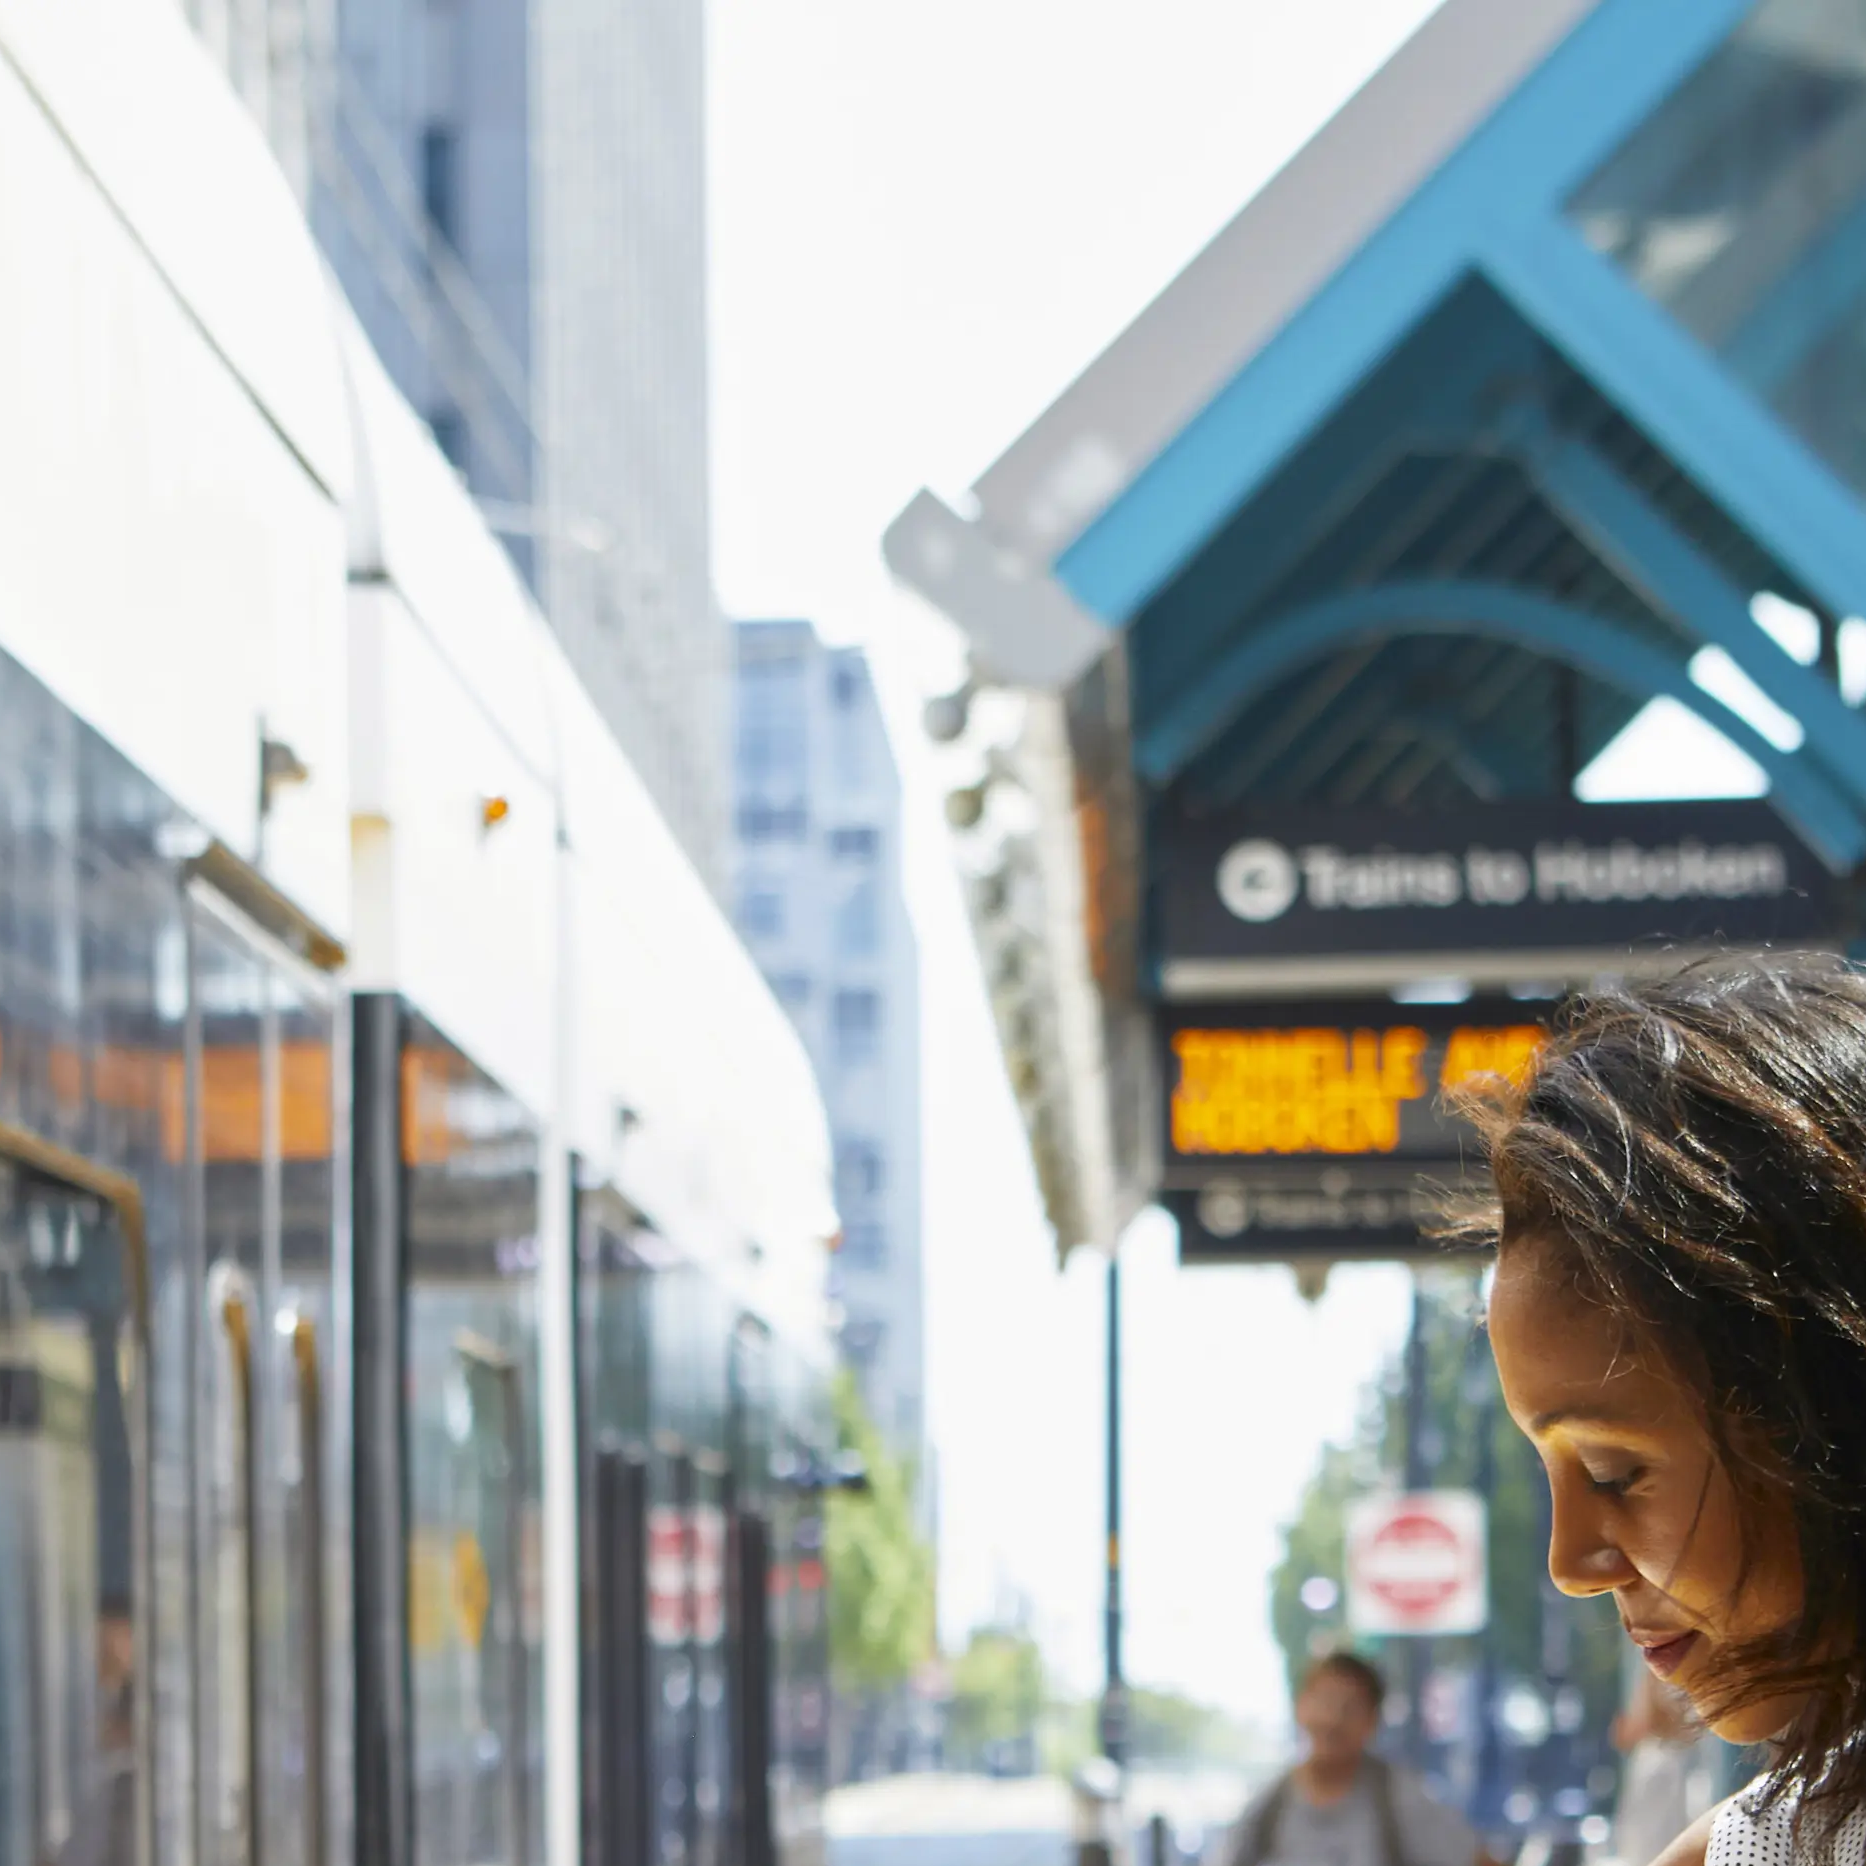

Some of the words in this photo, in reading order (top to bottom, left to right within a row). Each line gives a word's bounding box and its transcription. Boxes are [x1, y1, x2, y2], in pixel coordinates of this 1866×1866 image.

[1302, 845, 1462, 909] Trains
[1466, 849, 1531, 905] to
[1535, 842, 1787, 904] Hoboken
